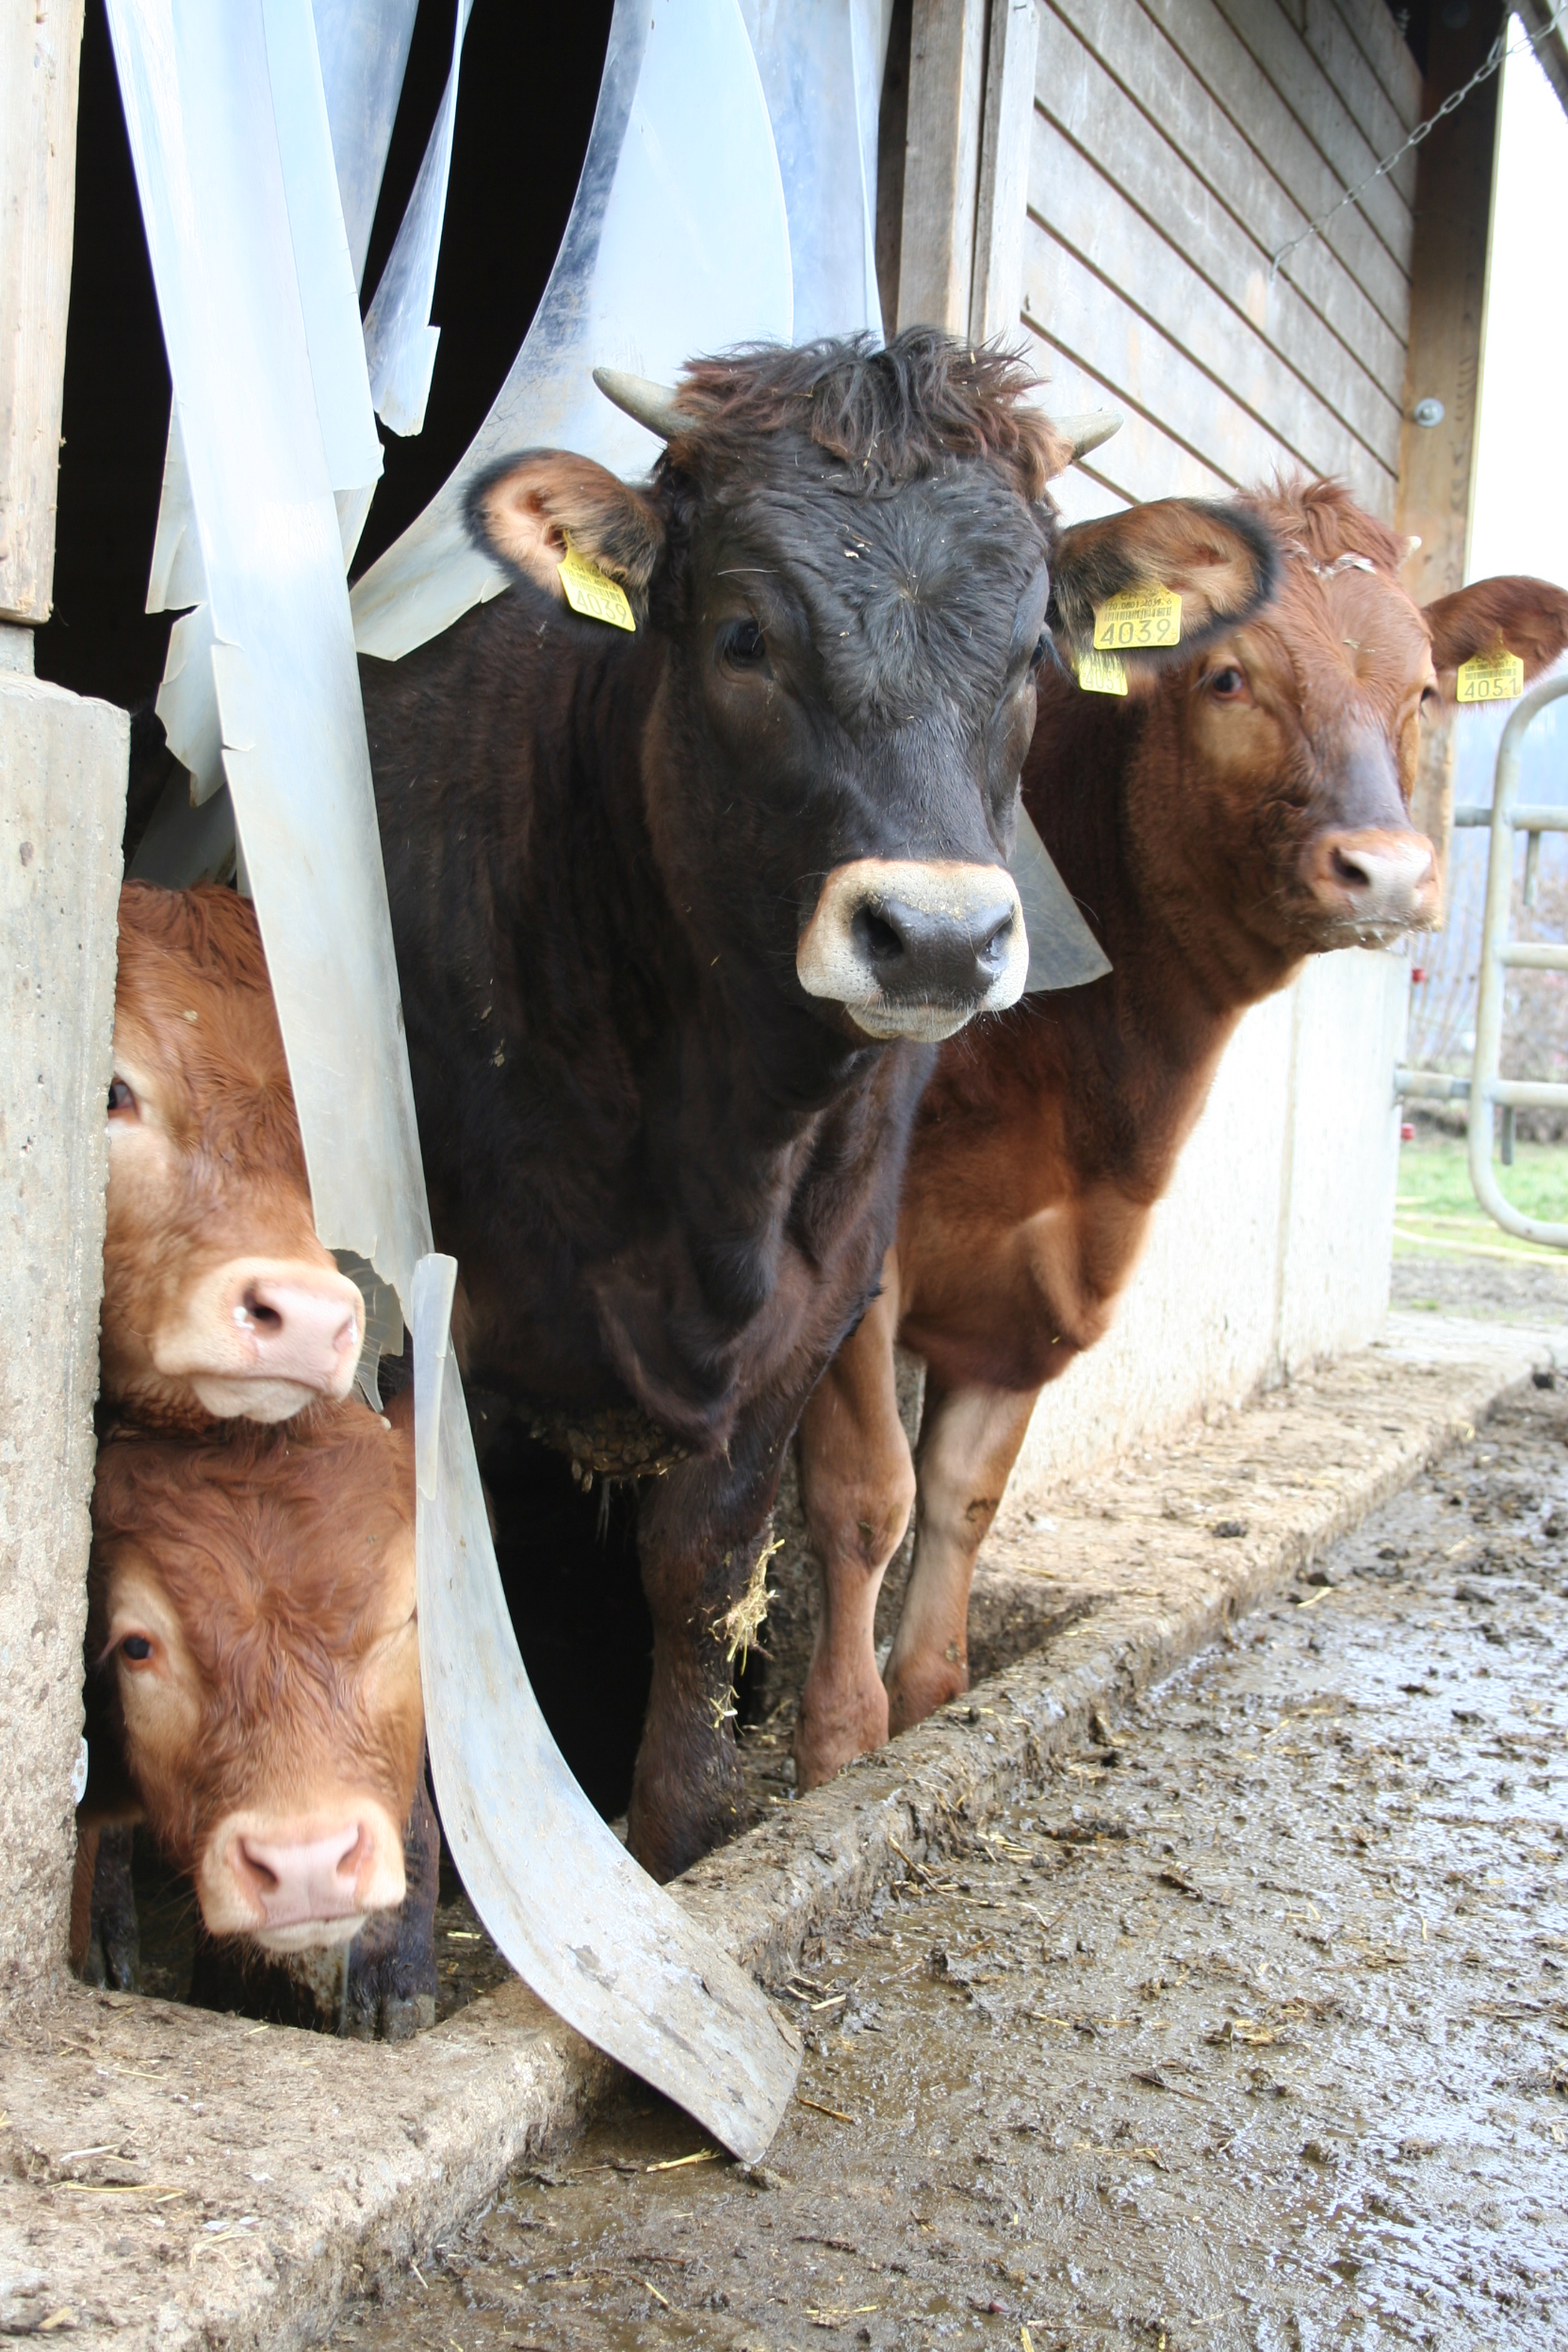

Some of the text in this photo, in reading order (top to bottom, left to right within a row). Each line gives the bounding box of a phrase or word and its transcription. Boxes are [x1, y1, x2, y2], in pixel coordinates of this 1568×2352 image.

[577, 590, 627, 624] 4039
[1100, 618, 1171, 645] 4039
[1464, 678, 1517, 698] 4051
